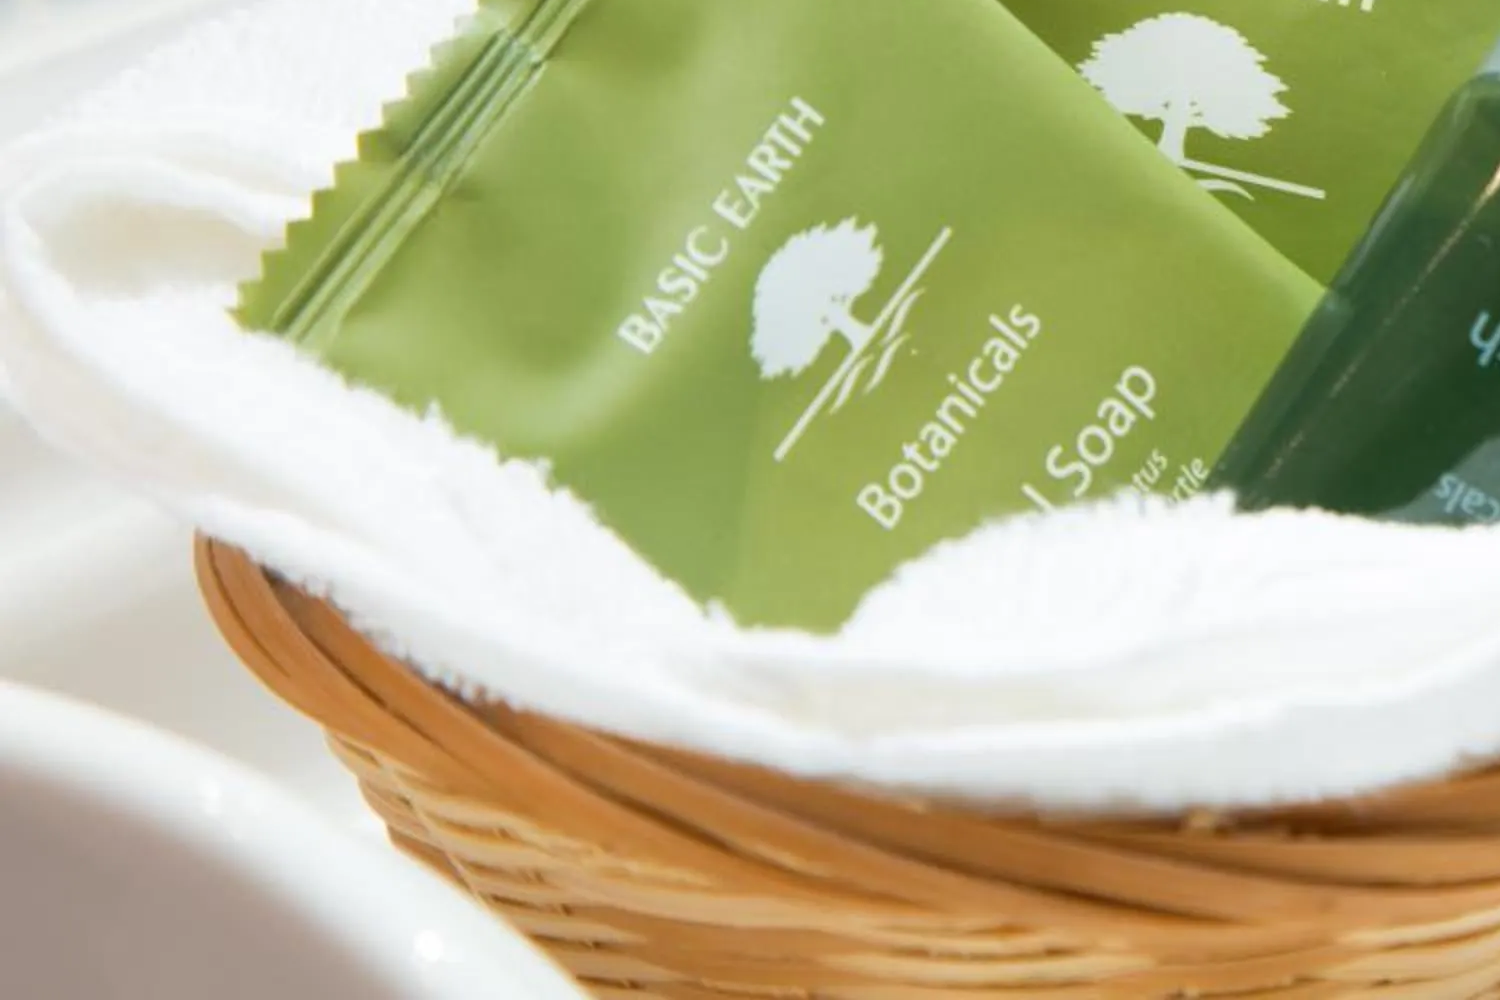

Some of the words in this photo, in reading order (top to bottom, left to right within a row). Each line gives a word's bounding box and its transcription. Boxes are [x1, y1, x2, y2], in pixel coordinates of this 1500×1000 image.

[617, 224, 729, 354] BASIC
[712, 95, 825, 229] EARTH
[856, 303, 1041, 530] Botanicals
[1046, 365, 1156, 496] Soap
